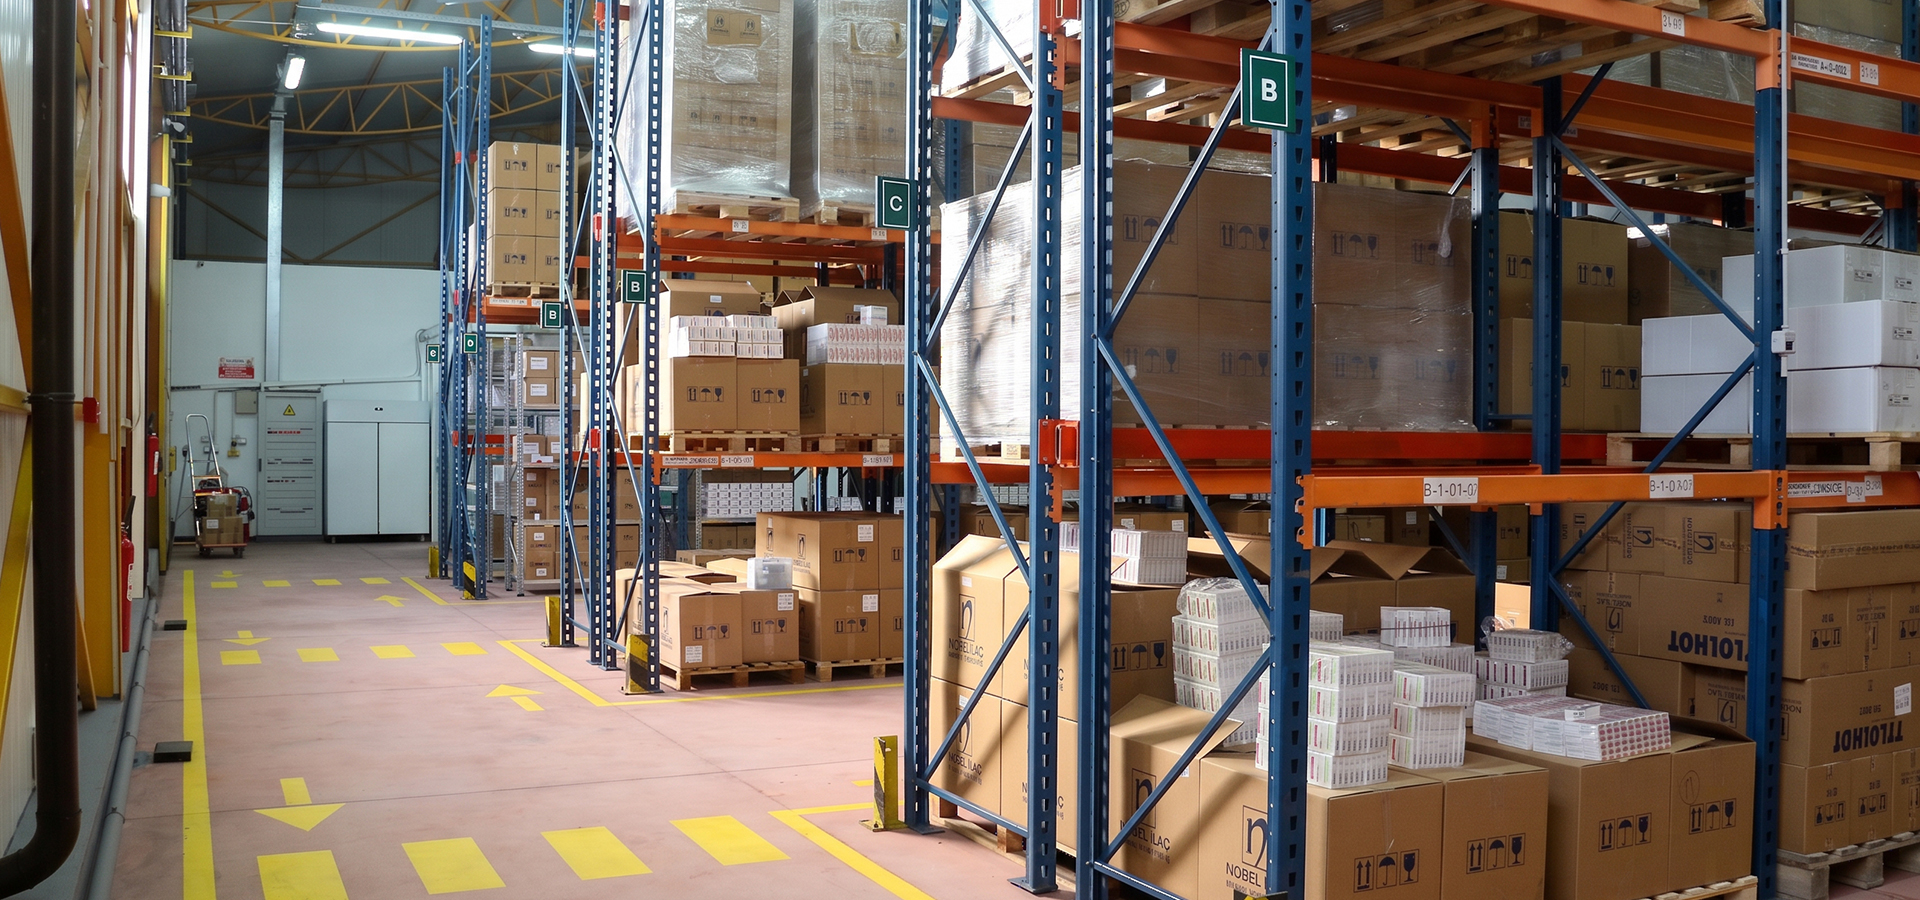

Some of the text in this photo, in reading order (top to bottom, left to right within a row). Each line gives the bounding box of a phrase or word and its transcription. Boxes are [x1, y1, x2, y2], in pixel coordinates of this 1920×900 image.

[1260, 77, 1278, 102] B
[889, 195, 903, 212] C
[631, 281, 641, 293] B
[548, 309, 557, 320] B
[1667, 629, 1748, 663] LOLHOT
[1225, 861, 1262, 888] NOBEL
